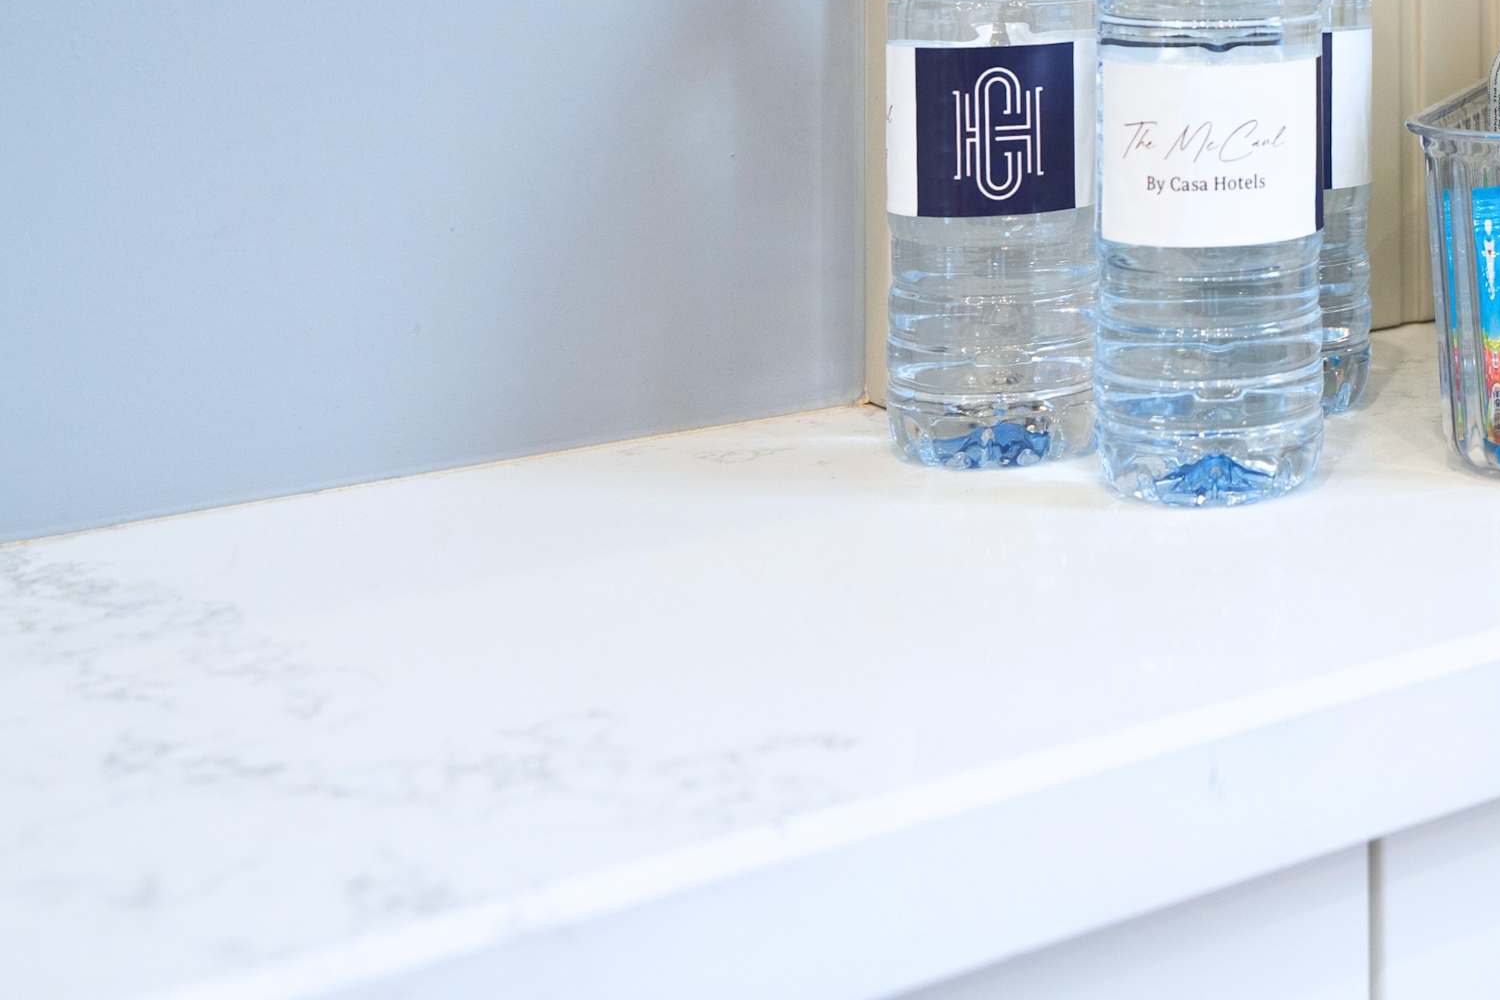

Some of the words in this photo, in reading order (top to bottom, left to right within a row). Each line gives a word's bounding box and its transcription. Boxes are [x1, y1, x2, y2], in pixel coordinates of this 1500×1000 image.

[1122, 121, 1158, 159] The
[1146, 176, 1165, 195] By
[1170, 177, 1208, 192] Casa
[1214, 174, 1266, 192] Hotels
